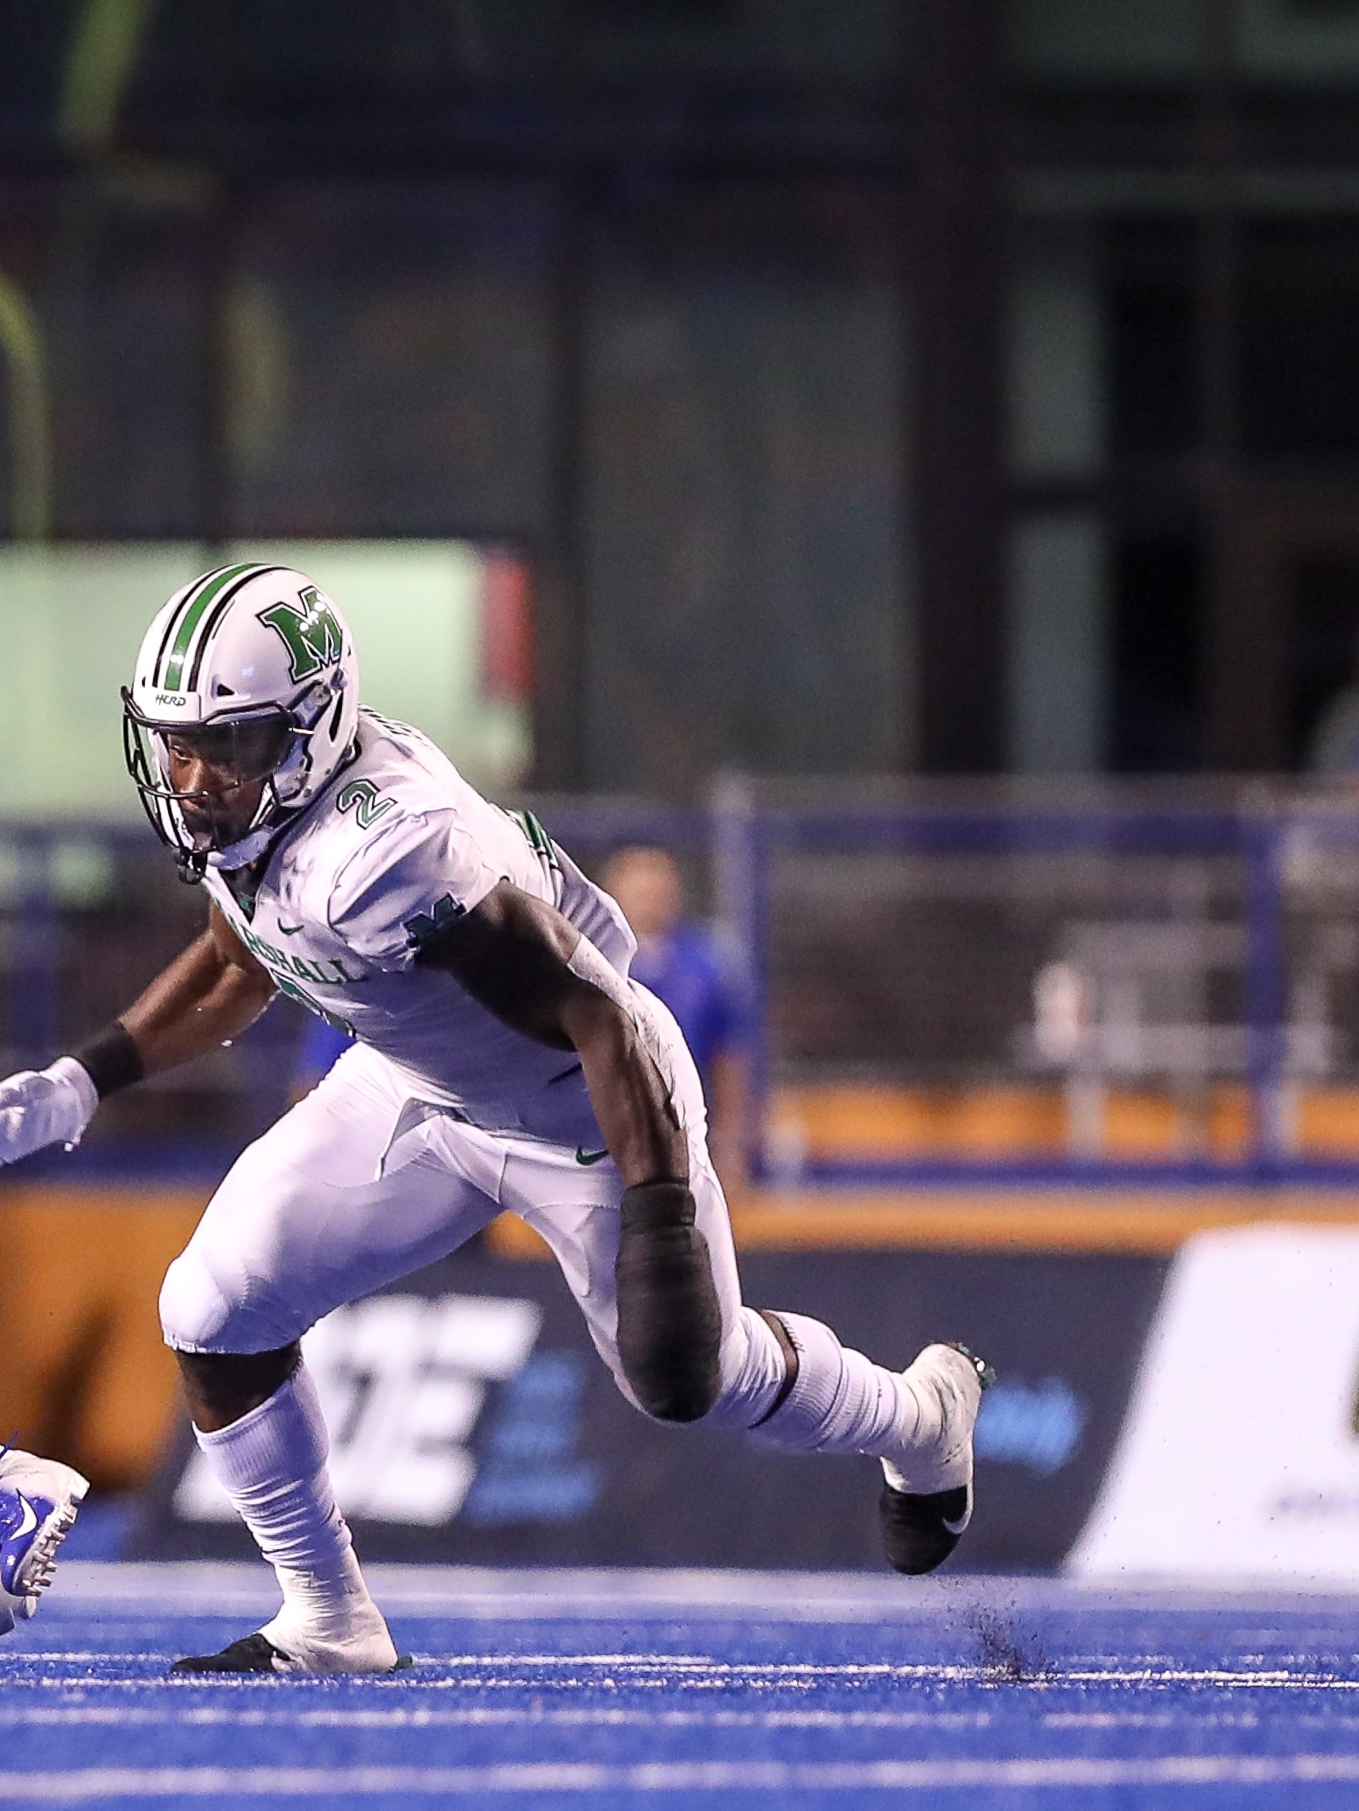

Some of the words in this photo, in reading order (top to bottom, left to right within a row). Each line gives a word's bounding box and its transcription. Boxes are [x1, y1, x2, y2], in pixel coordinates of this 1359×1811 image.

[255, 585, 343, 685] M
[155, 694, 187, 707] HERD
[336, 778, 398, 831] 2
